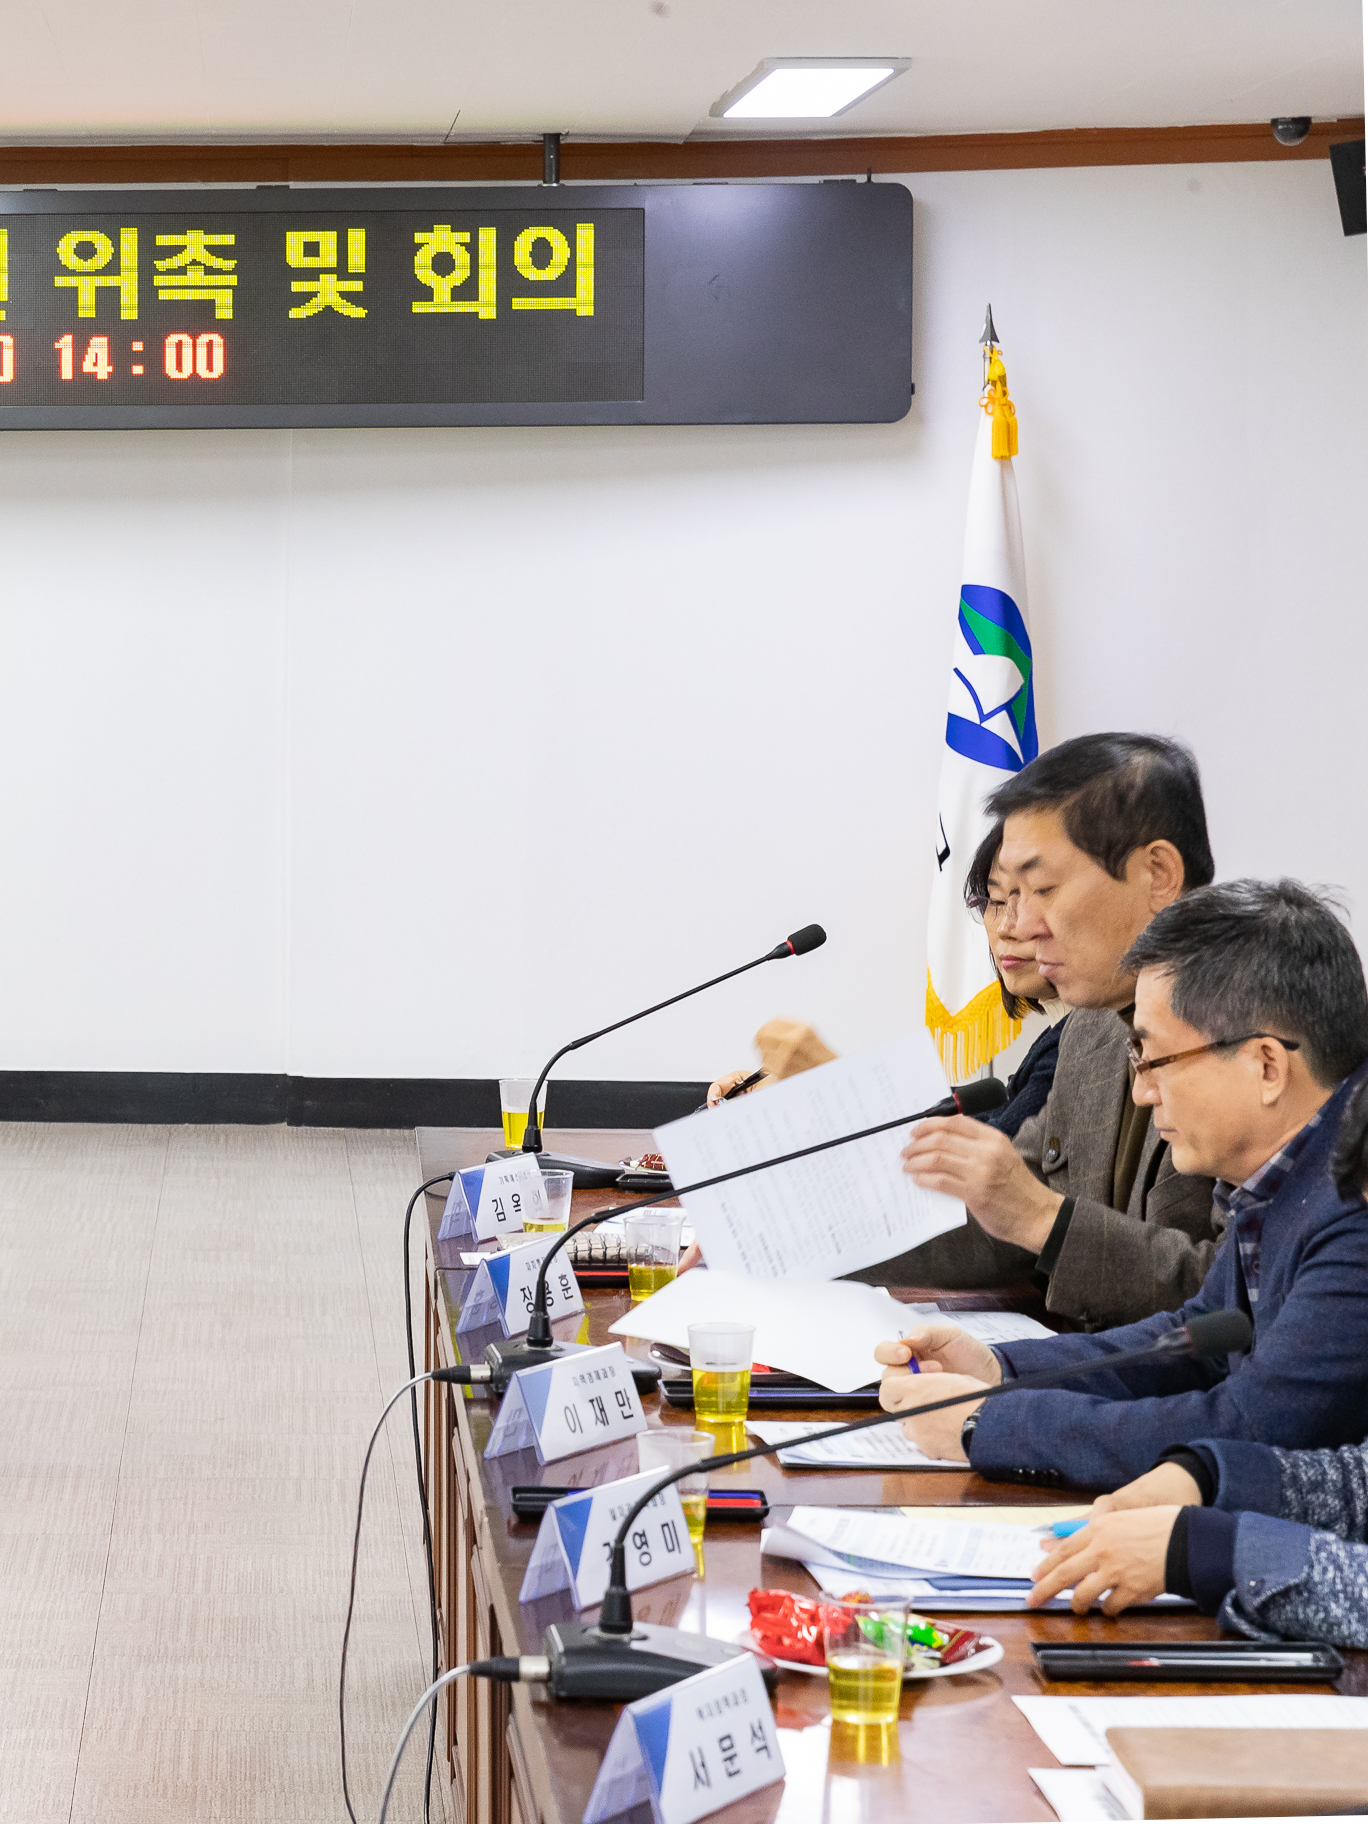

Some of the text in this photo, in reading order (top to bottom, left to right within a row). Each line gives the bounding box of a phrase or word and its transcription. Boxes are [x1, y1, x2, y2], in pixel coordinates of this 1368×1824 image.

[53, 227, 237, 320] 위촉
[285, 228, 368, 319] 및
[411, 222, 595, 320] 회의
